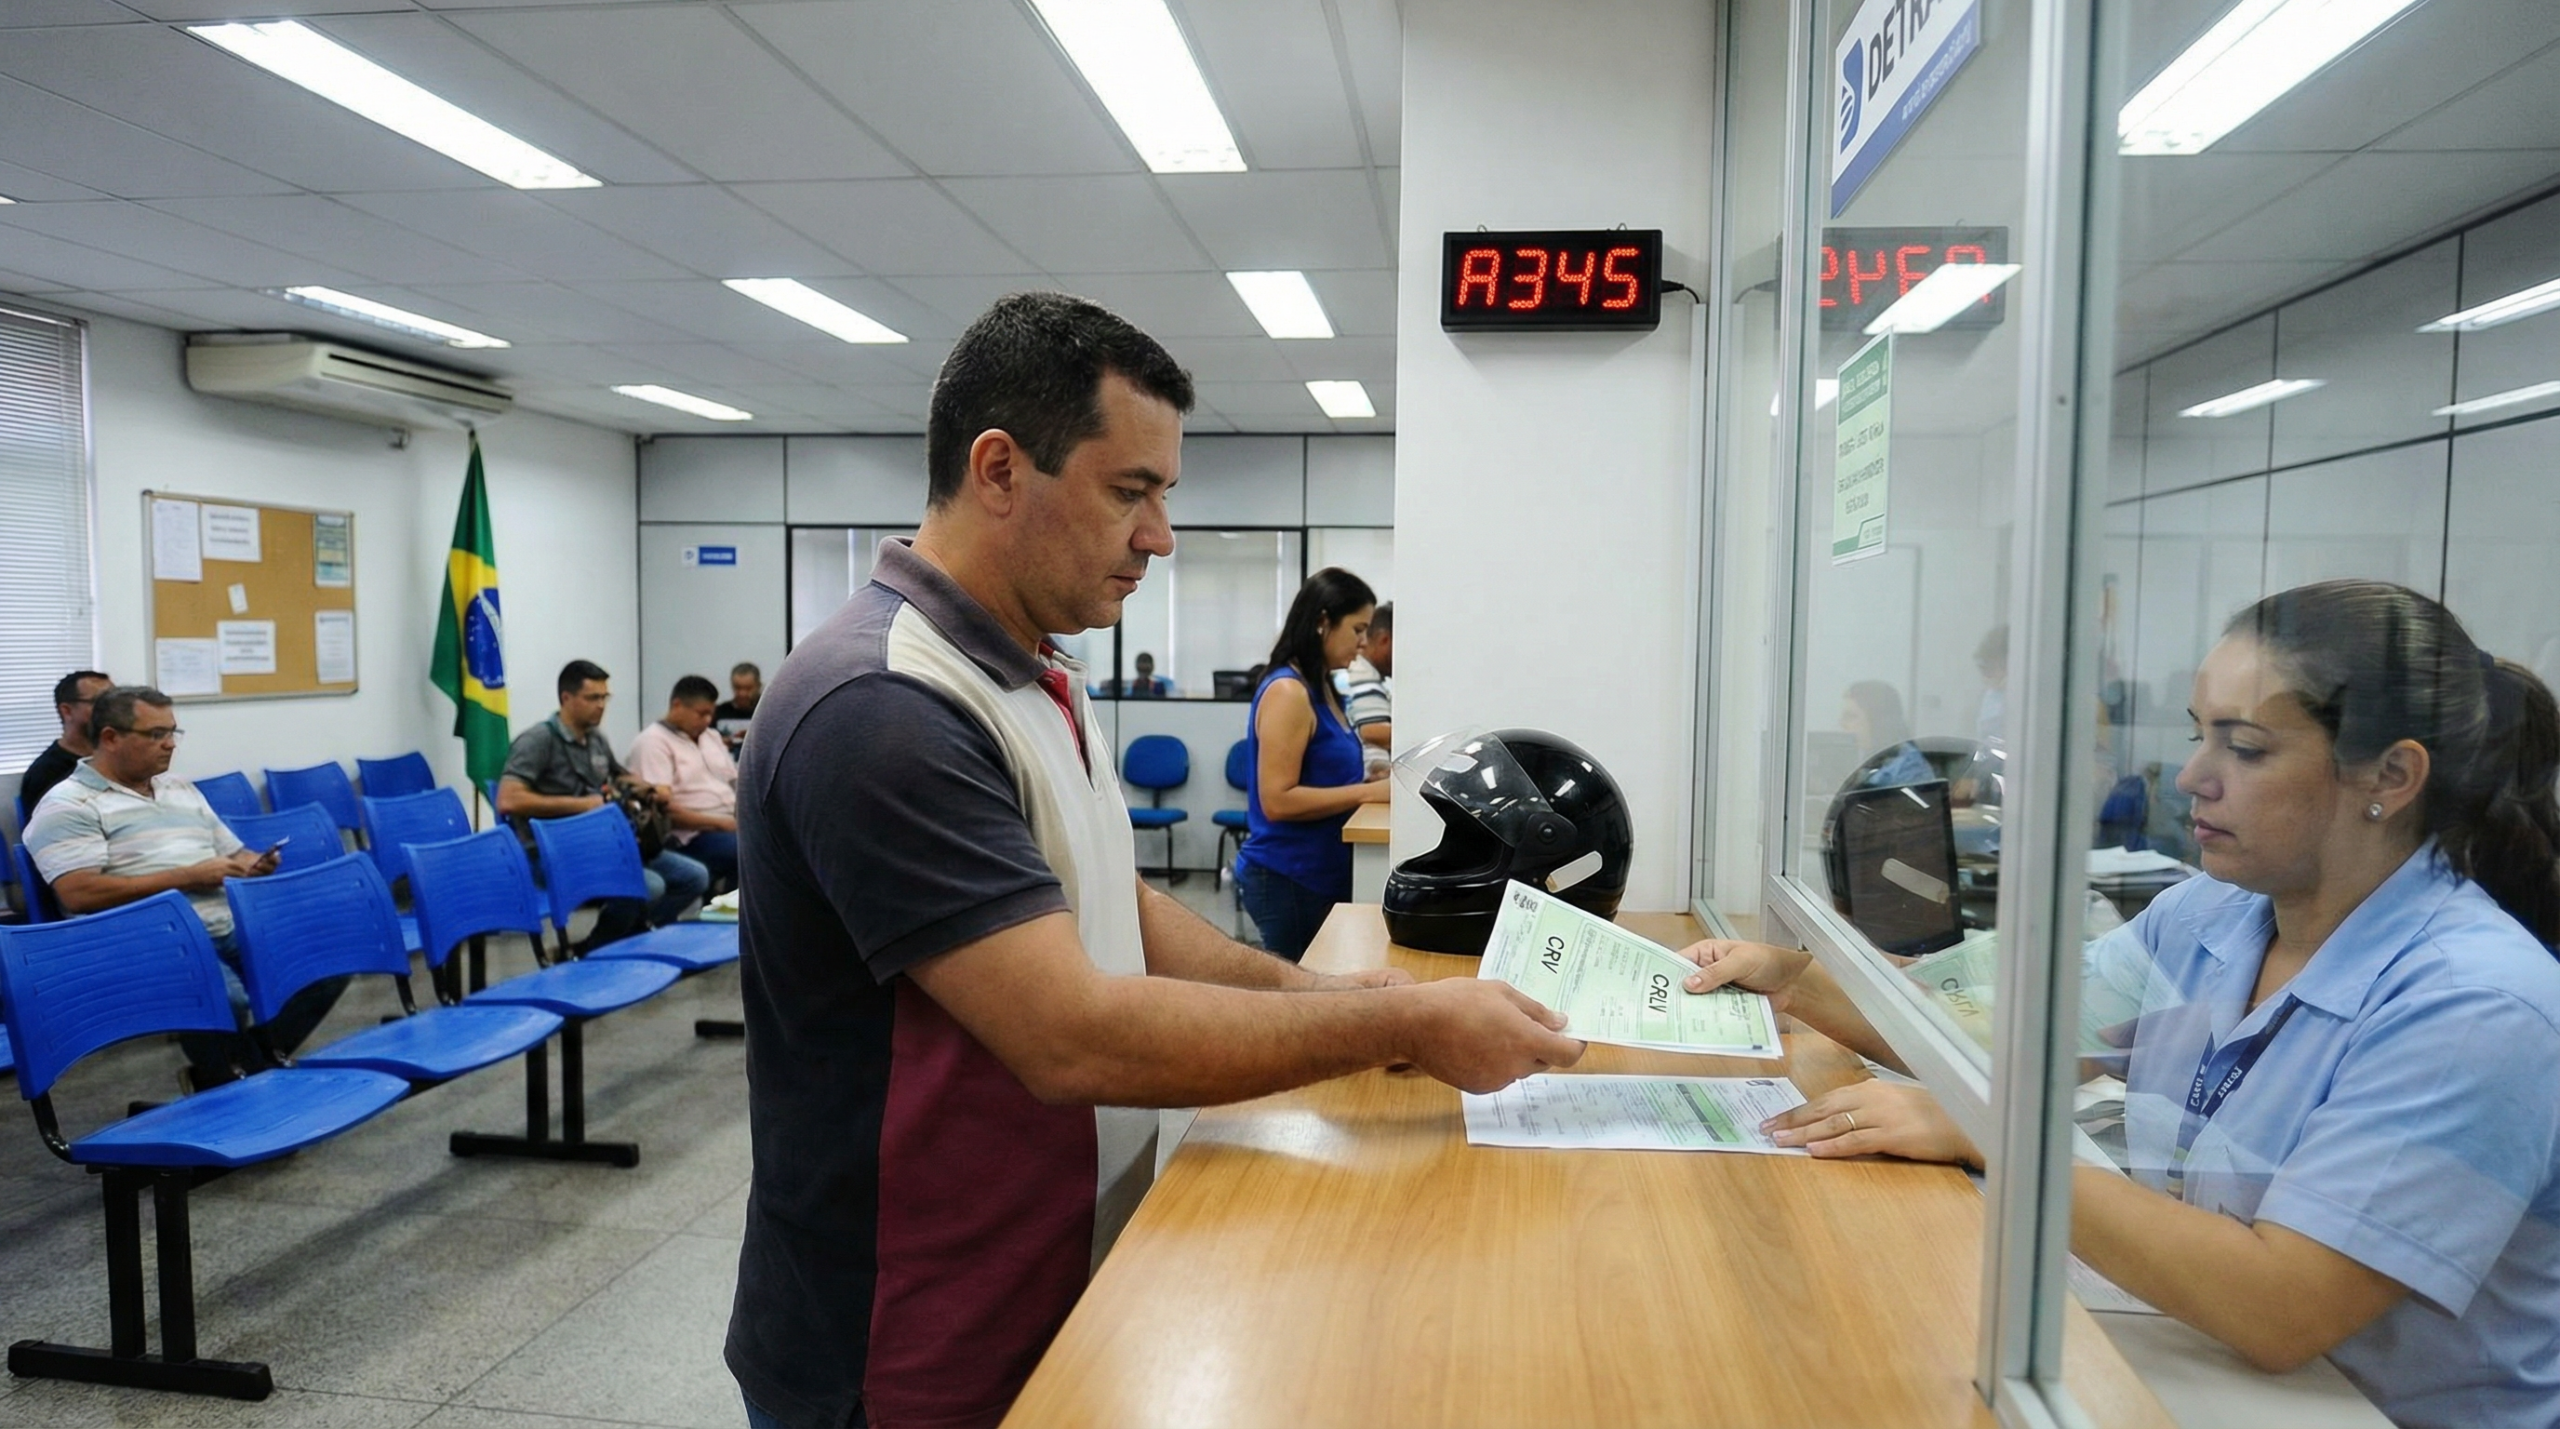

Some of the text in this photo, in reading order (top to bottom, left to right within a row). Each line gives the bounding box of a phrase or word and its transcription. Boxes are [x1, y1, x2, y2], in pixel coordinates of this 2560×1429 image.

[1458, 248, 1639, 308] A345
[1541, 935, 1565, 975] CRV
[1649, 973, 1669, 1014] CRLV
